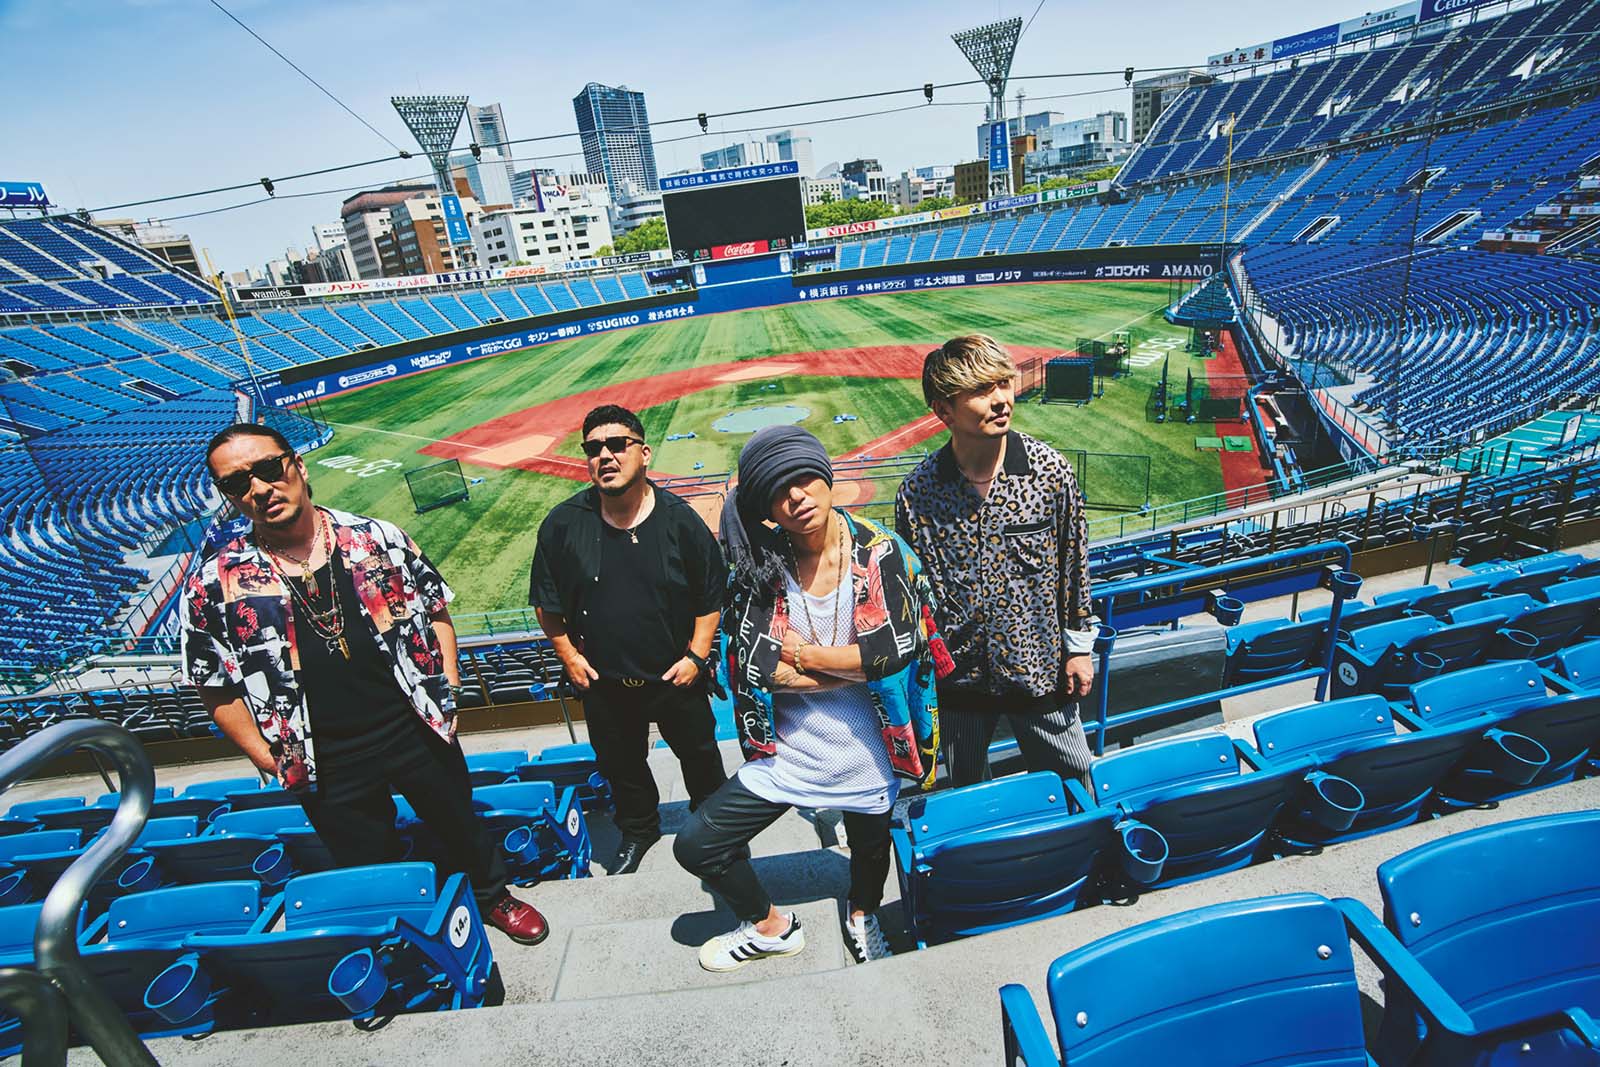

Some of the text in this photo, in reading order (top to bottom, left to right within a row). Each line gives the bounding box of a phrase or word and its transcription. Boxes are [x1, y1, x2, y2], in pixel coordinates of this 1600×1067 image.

[996, 271, 1021, 281] ノジマ
[1105, 265, 1150, 277] コロワイド
[1161, 264, 1213, 277] AMANO
[933, 275, 965, 286] 大洋建設
[251, 288, 292, 299] wamiles
[327, 283, 369, 294] ハーバー
[809, 286, 848, 299] 横浜銀行
[596, 314, 640, 331] SUGIKO
[275, 389, 315, 406] EVA AIR
